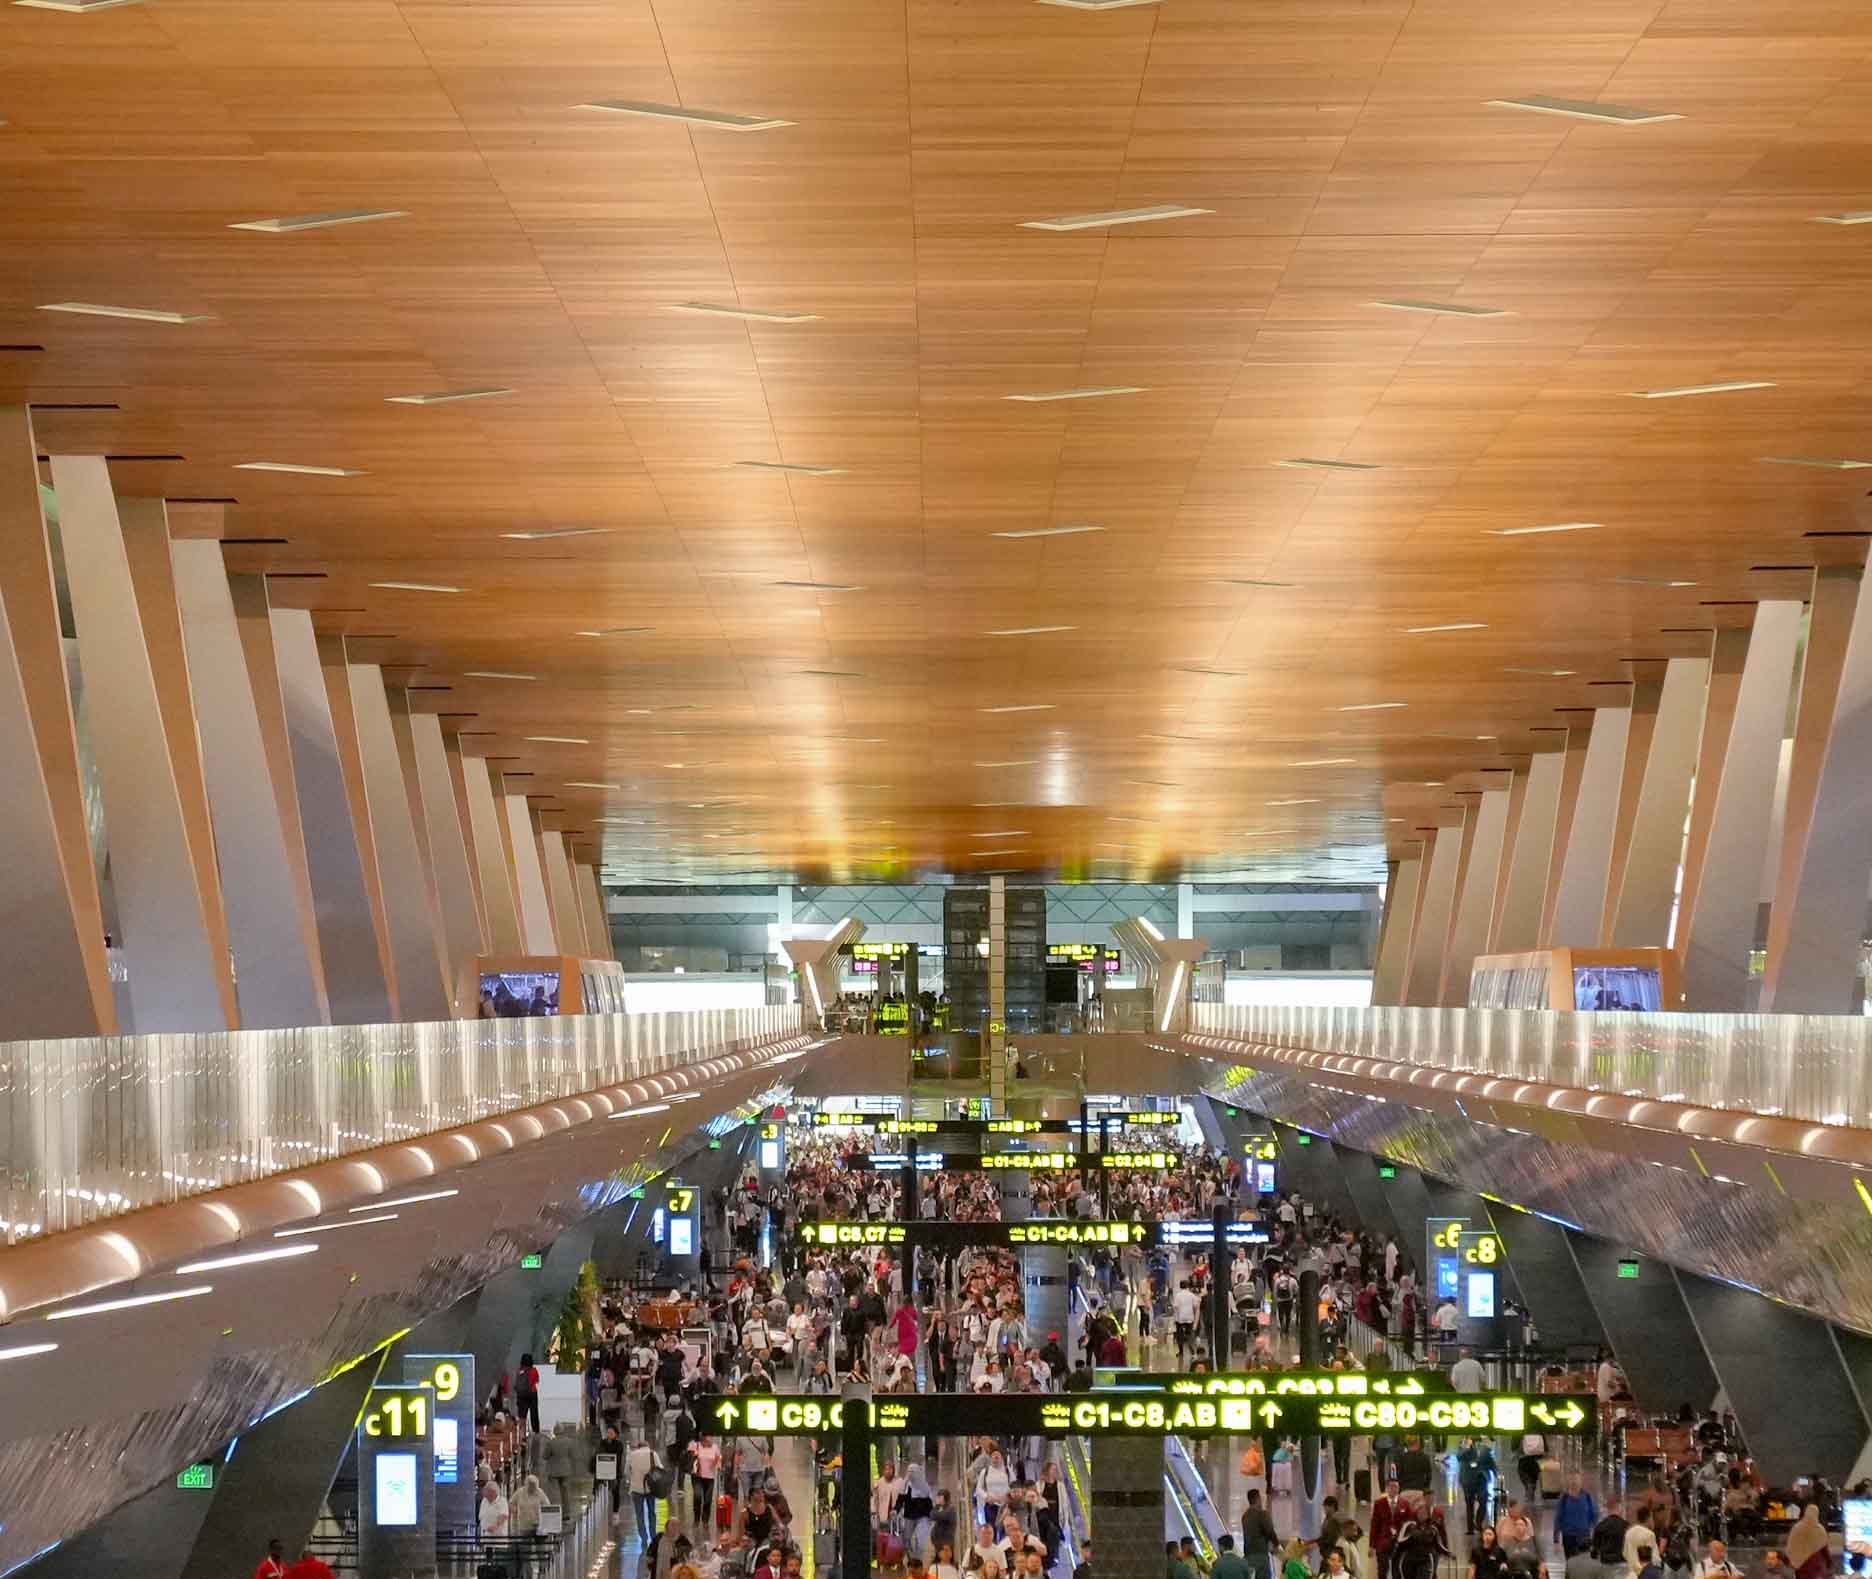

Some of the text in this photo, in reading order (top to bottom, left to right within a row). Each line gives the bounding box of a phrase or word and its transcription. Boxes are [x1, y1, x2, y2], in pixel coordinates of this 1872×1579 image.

[669, 1190, 693, 1211] c7
[1465, 1237, 1496, 1263] c8
[364, 1396, 427, 1437] c11
[1073, 1402, 1217, 1431] C1-C8,AB
[1354, 1401, 1490, 1428] C80-C93
[183, 1473, 206, 1485] EXIT
